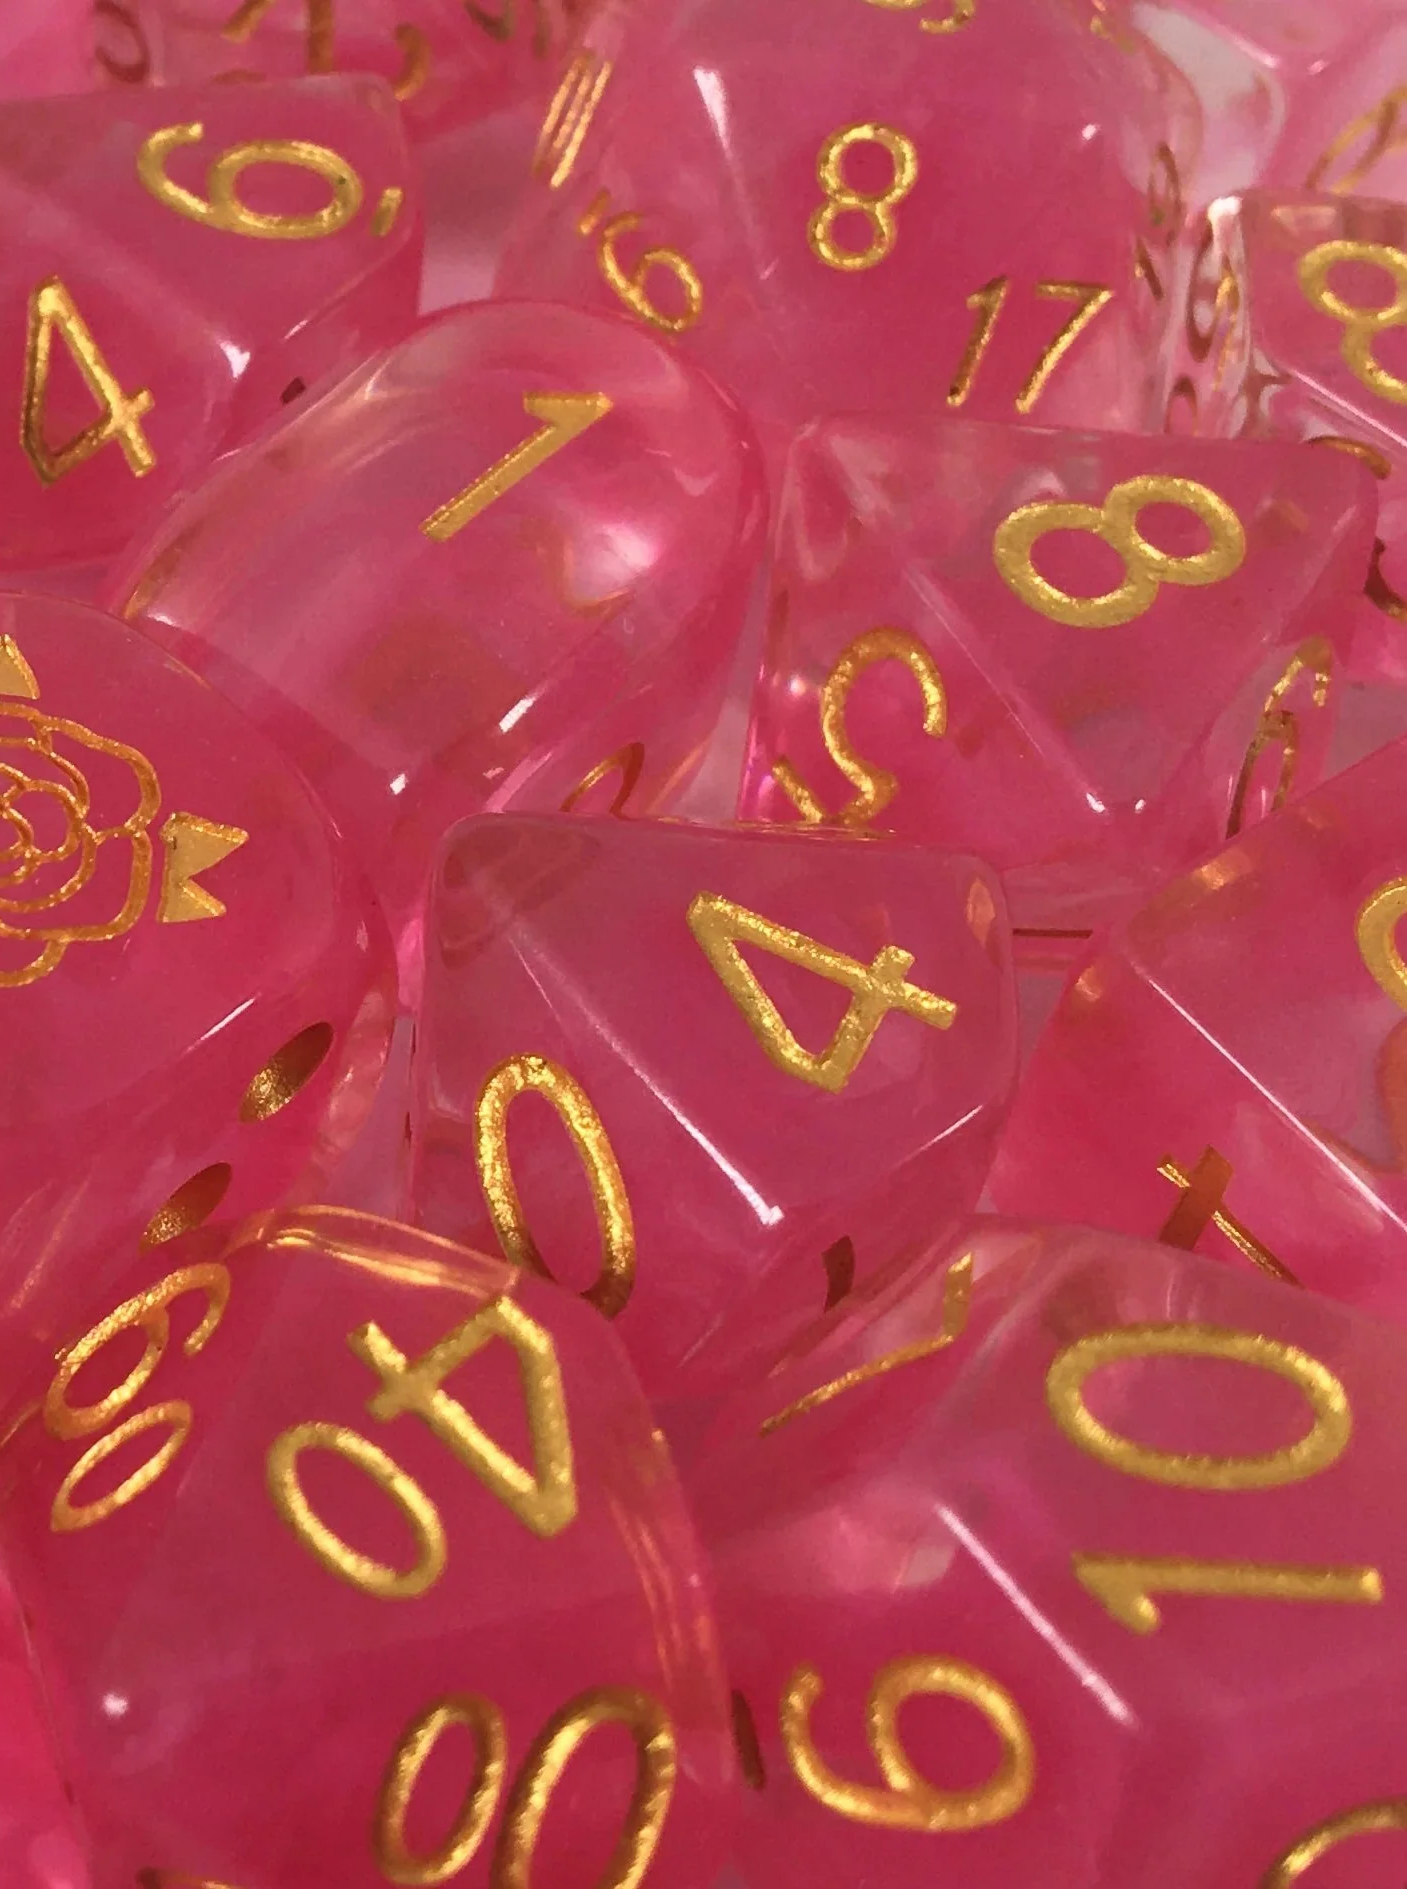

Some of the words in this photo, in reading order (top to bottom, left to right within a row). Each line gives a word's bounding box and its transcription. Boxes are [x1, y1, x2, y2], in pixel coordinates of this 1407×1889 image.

[807, 121, 917, 271] 8
[20, 275, 156, 487] 4
[945, 276, 1115, 414] 17
[420, 390, 612, 542] 1
[993, 474, 1246, 628] 8
[687, 892, 958, 1094] 4
[474, 1052, 637, 1319] 0
[265, 1294, 578, 1598] 40
[1045, 1321, 1385, 1636] 10
[369, 1684, 677, 1889] 00
